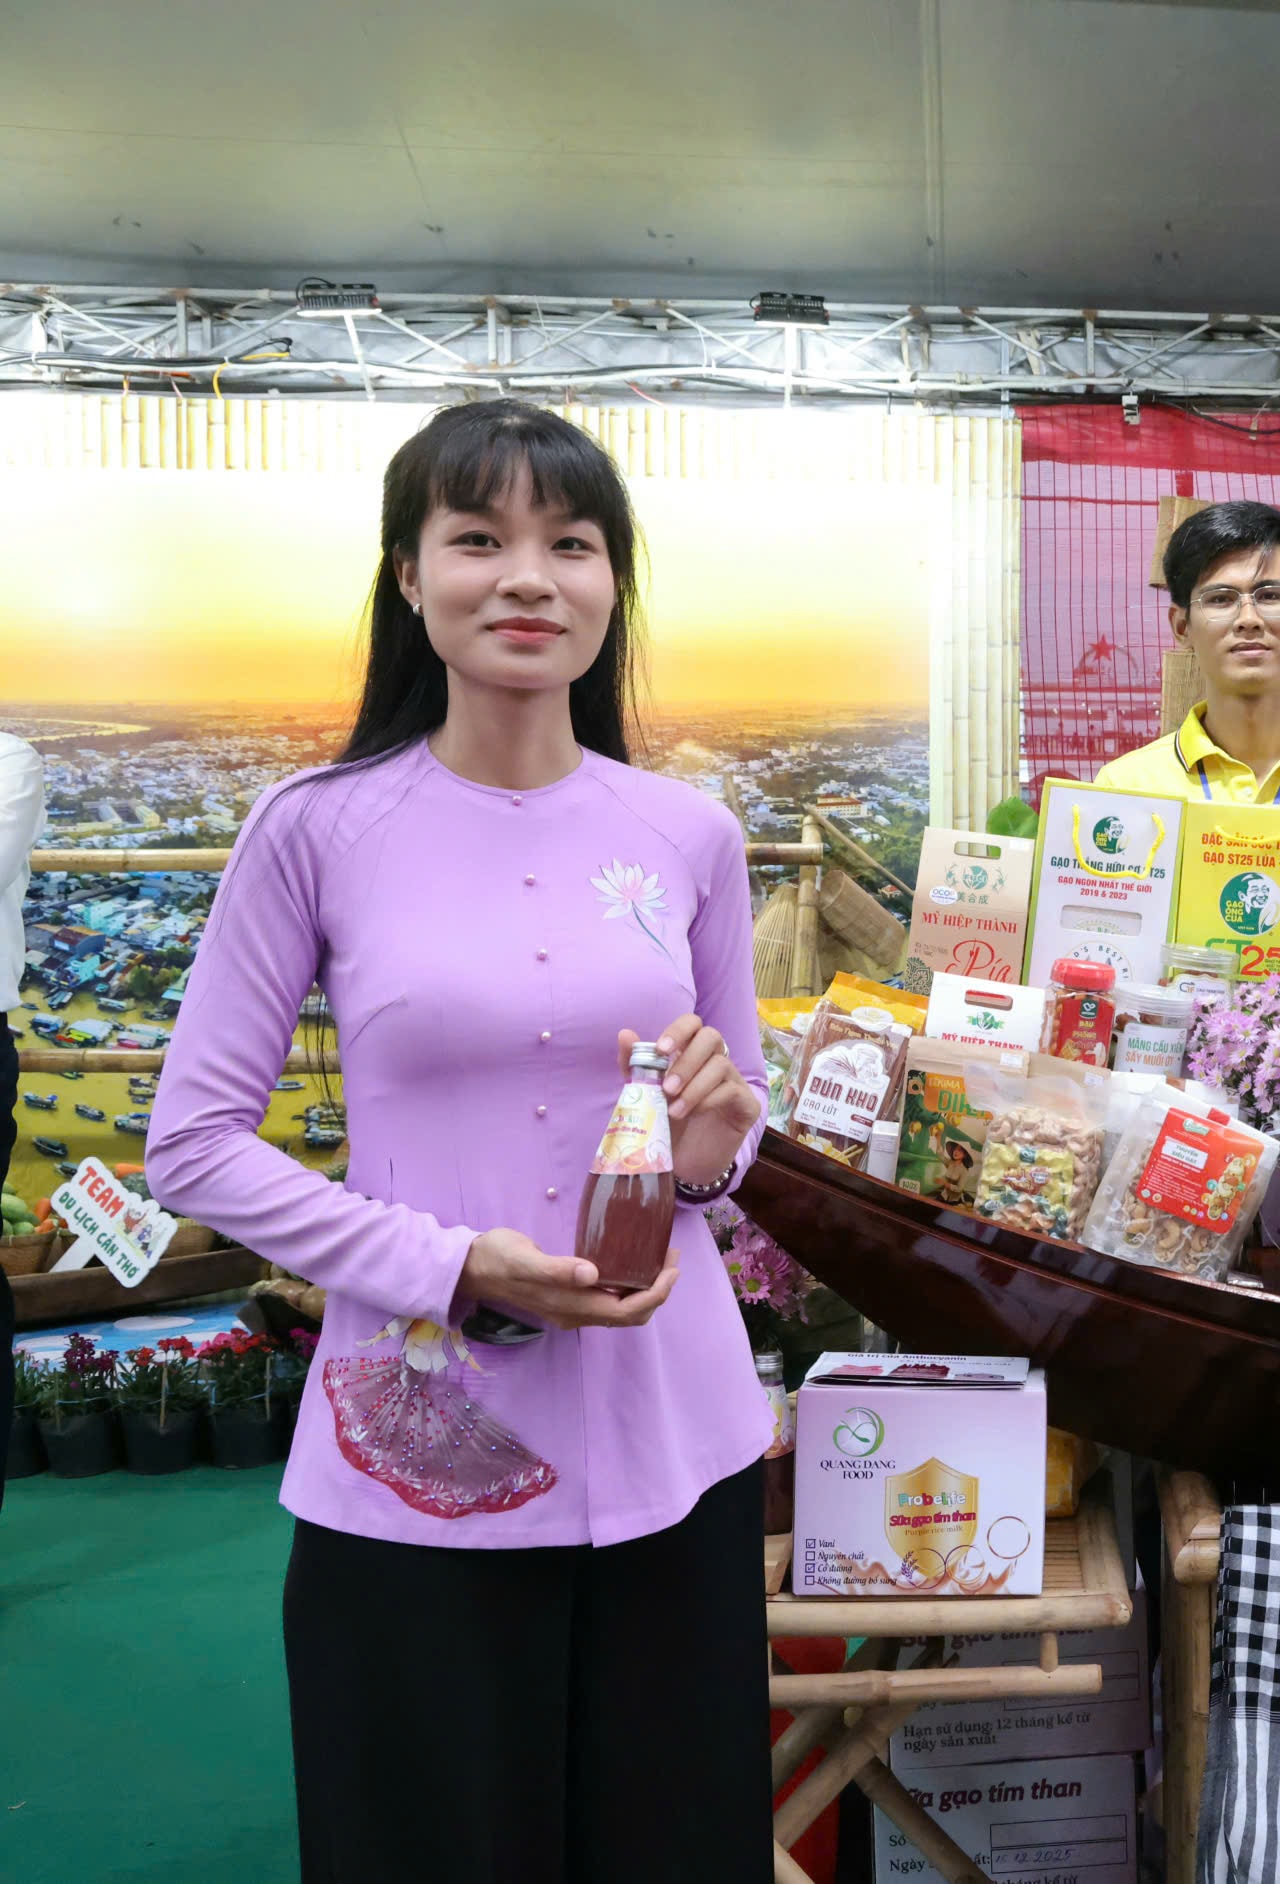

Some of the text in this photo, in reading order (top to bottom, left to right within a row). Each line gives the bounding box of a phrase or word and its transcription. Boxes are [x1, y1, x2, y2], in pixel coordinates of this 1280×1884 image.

[1051, 856, 1070, 869] GẠO
[1203, 851, 1224, 866] GẠO
[1227, 853, 1253, 866] ST25
[1080, 888, 1128, 900] 2019 2023
[943, 914, 973, 929] HIỆP
[976, 918, 1017, 934] THÀNH
[79, 1166, 125, 1218] TEAM
[58, 1191, 76, 1210] DU
[73, 1207, 99, 1235] LỊCH
[820, 1460, 895, 1471] QUANG DANG
[843, 1471, 873, 1480] FOOD
[818, 1551, 850, 1563] Nguyên
[817, 1575, 841, 1585] Không
[903, 1725, 933, 1740] Hạn
[996, 1718, 1011, 1730] 12
[1015, 1714, 1053, 1732] tháng
[904, 1737, 937, 1753] ngày
[939, 1778, 1082, 1813] gạo tím than
[890, 1858, 925, 1873] Ngày
